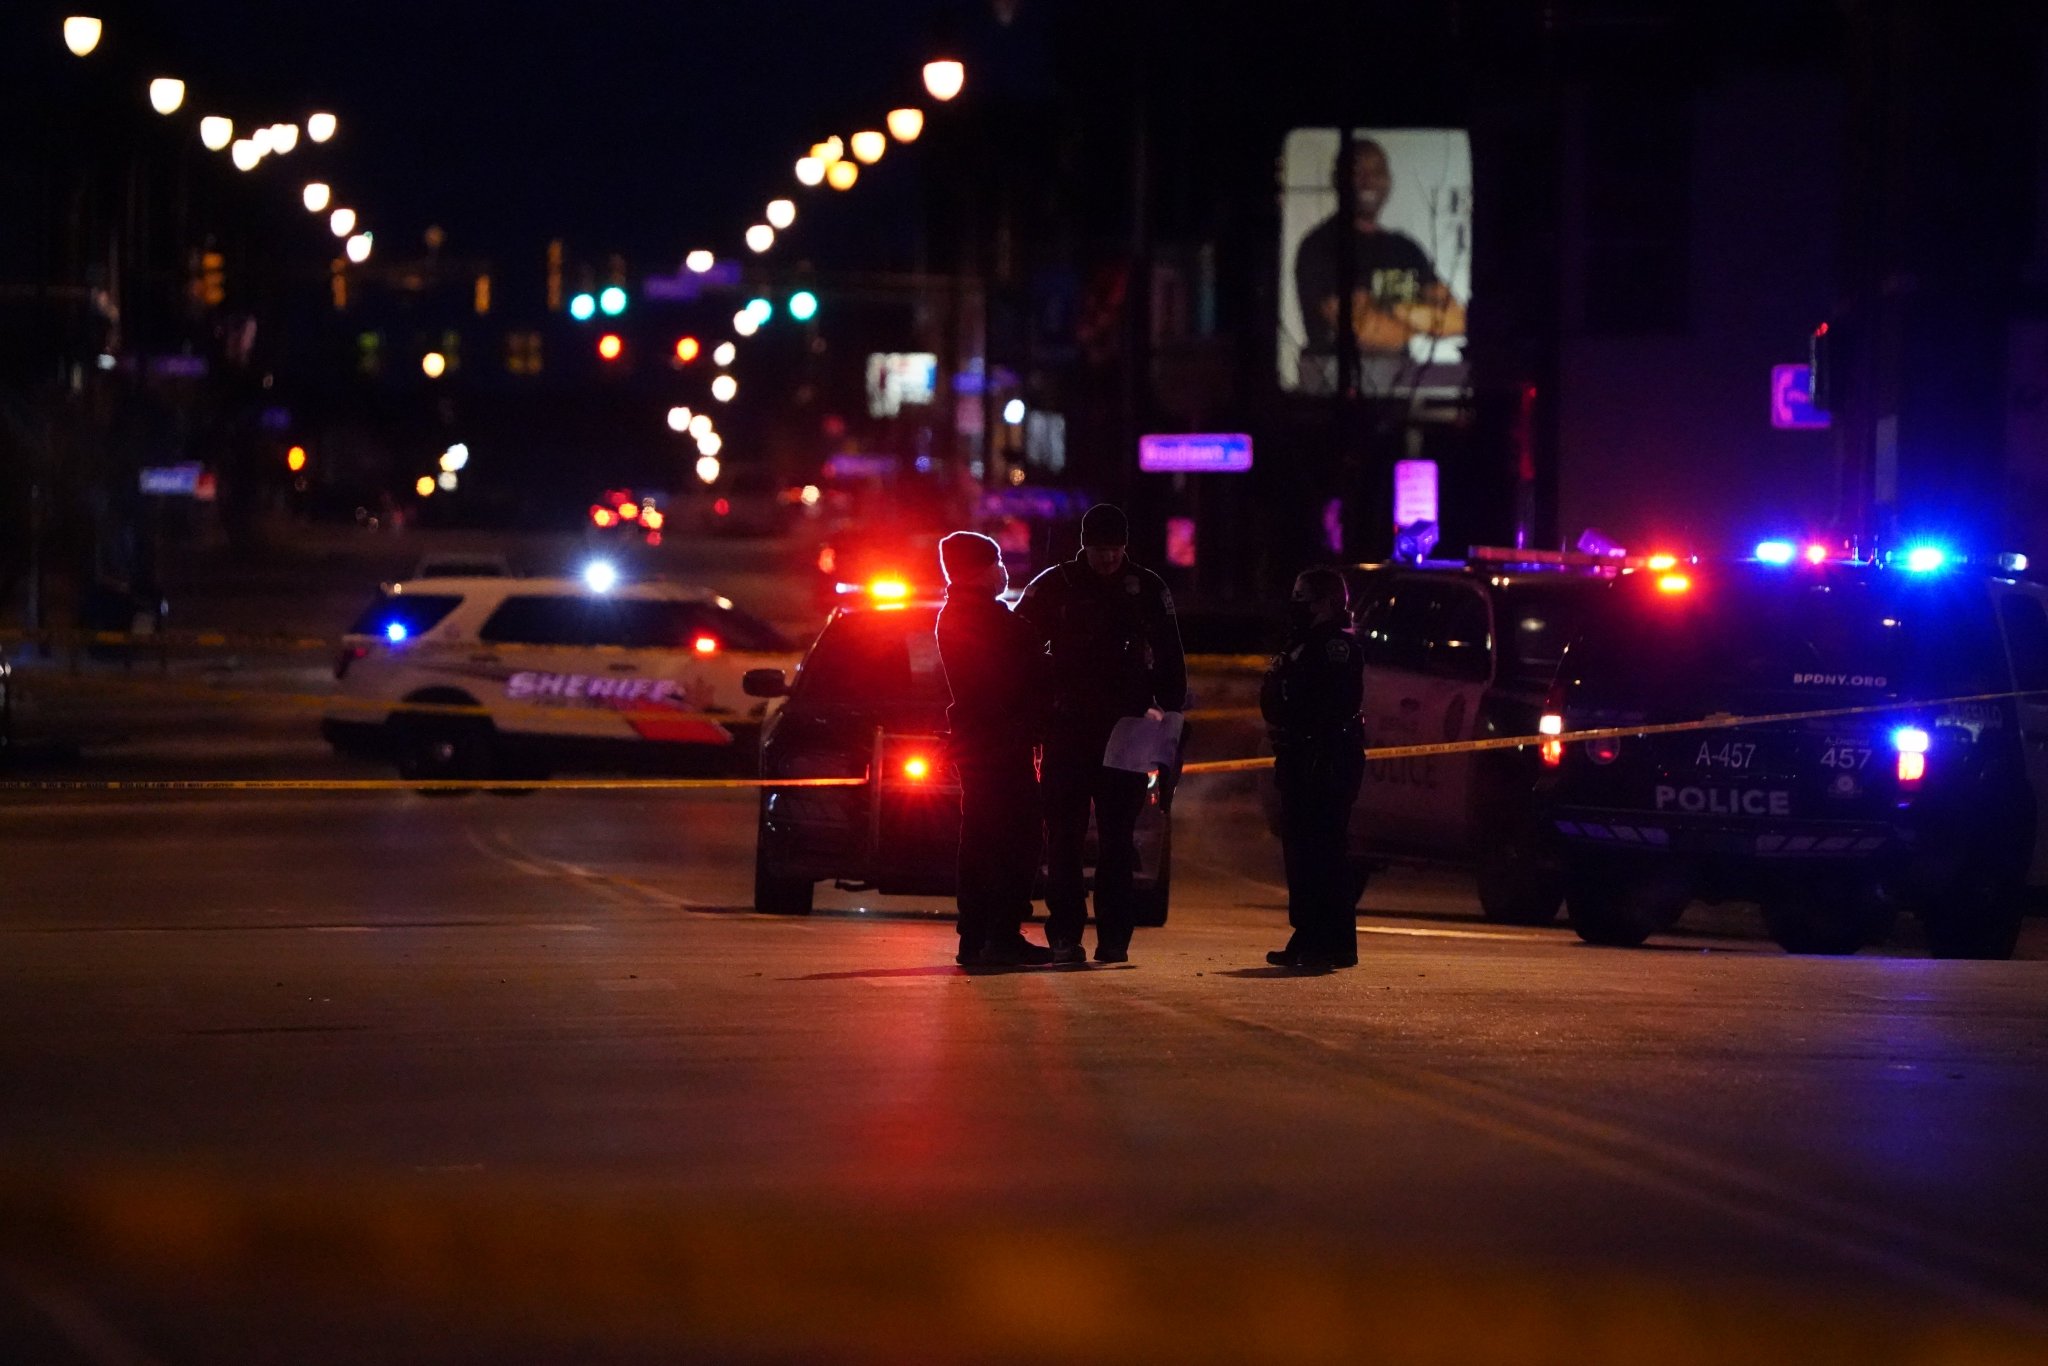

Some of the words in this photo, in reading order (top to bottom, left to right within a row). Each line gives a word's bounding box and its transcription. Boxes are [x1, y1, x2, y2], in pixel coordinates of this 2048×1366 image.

[507, 671, 686, 702] SHERIFF
[1793, 672, 1888, 688] BPDNY.ORG
[1695, 741, 1756, 769] A-457
[1820, 747, 1872, 770] 457
[1655, 784, 1790, 815] POLICE
